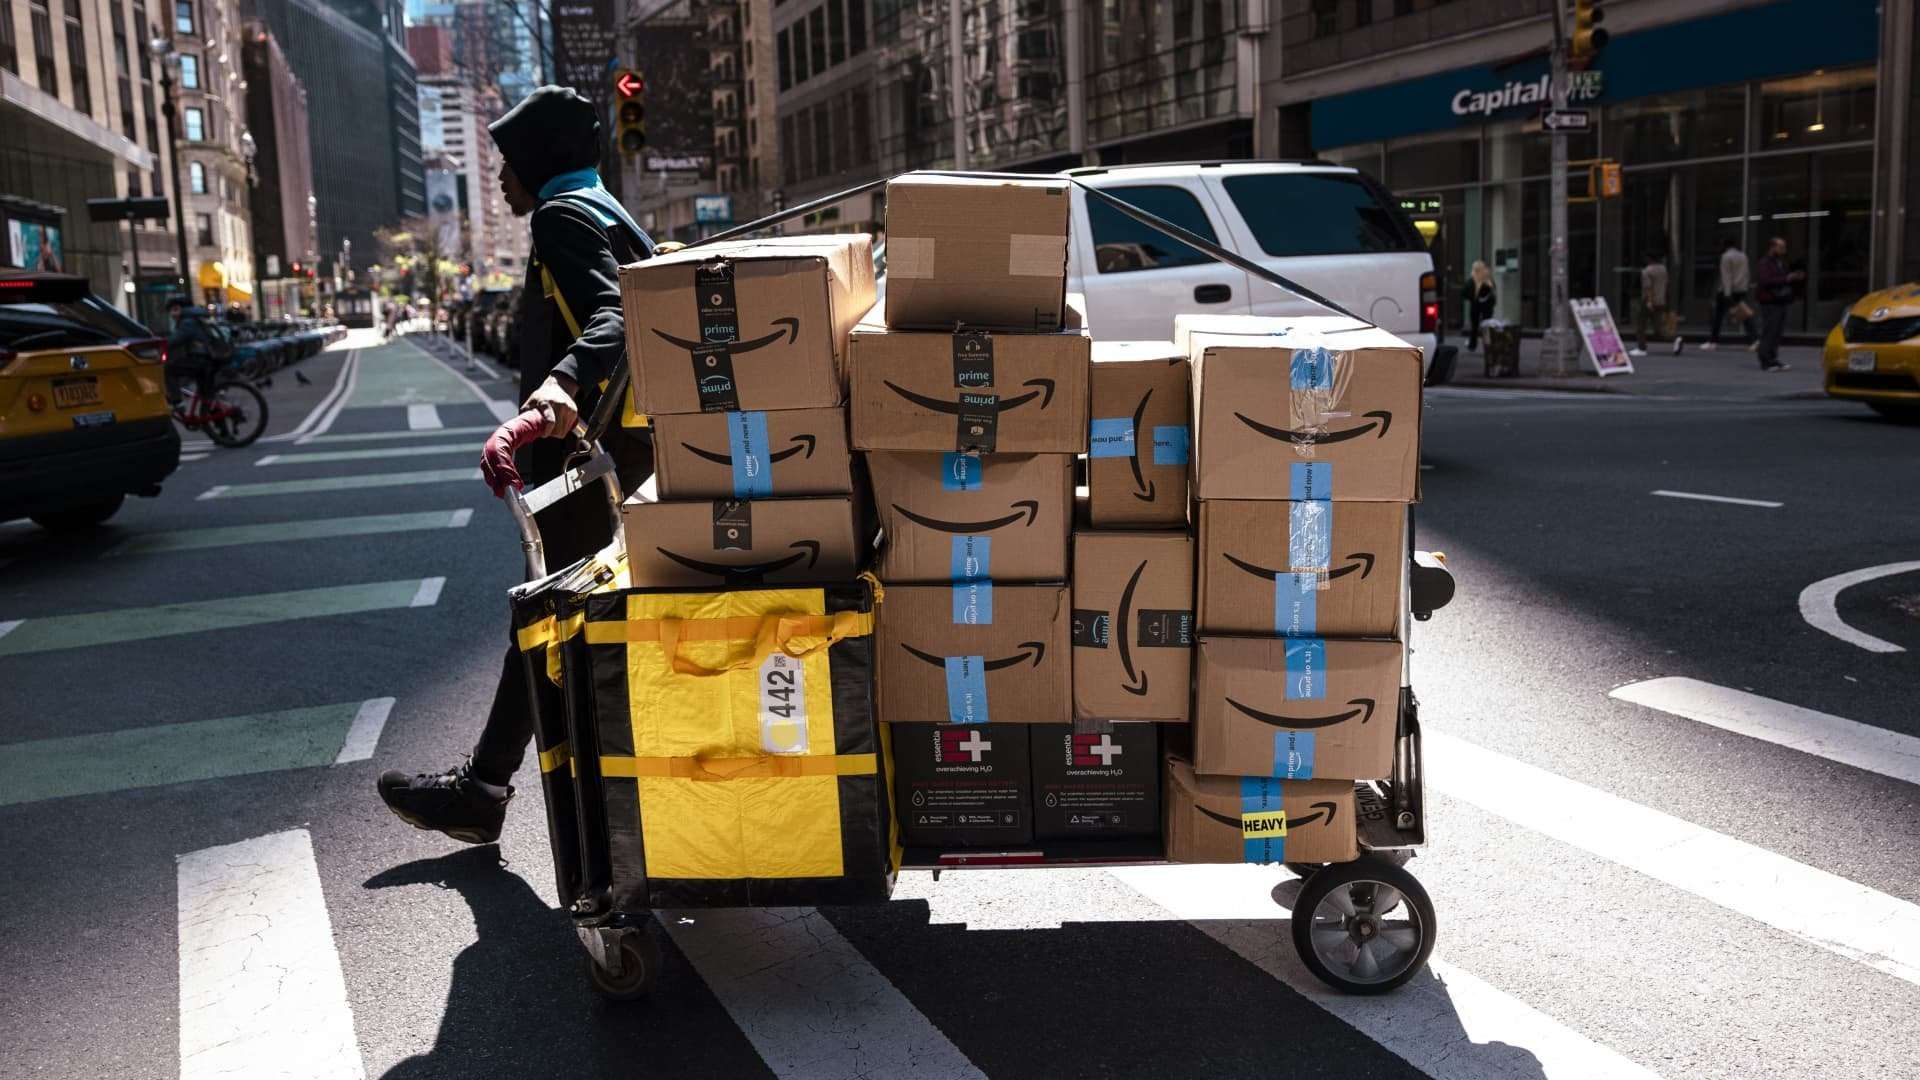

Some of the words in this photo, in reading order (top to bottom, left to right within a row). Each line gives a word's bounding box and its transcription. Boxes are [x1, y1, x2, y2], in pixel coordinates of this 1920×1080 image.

[1451, 73, 1549, 116] Capital
[704, 324, 735, 337] prime
[959, 370, 989, 382] prime
[701, 381, 731, 394] prime
[964, 395, 995, 406] prime
[744, 455, 754, 477] prime
[1101, 615, 1109, 644] prime
[1179, 615, 1190, 643] prime
[1305, 665, 1312, 675] on
[767, 670, 796, 718] 442
[1303, 676, 1313, 697] prime
[933, 730, 942, 762] essentia
[1063, 734, 1072, 766] essentia
[936, 765, 979, 773] overachieving
[1287, 752, 1295, 773] prime
[1354, 783, 1383, 821] GEMIN
[1243, 818, 1284, 832] HEAVY
